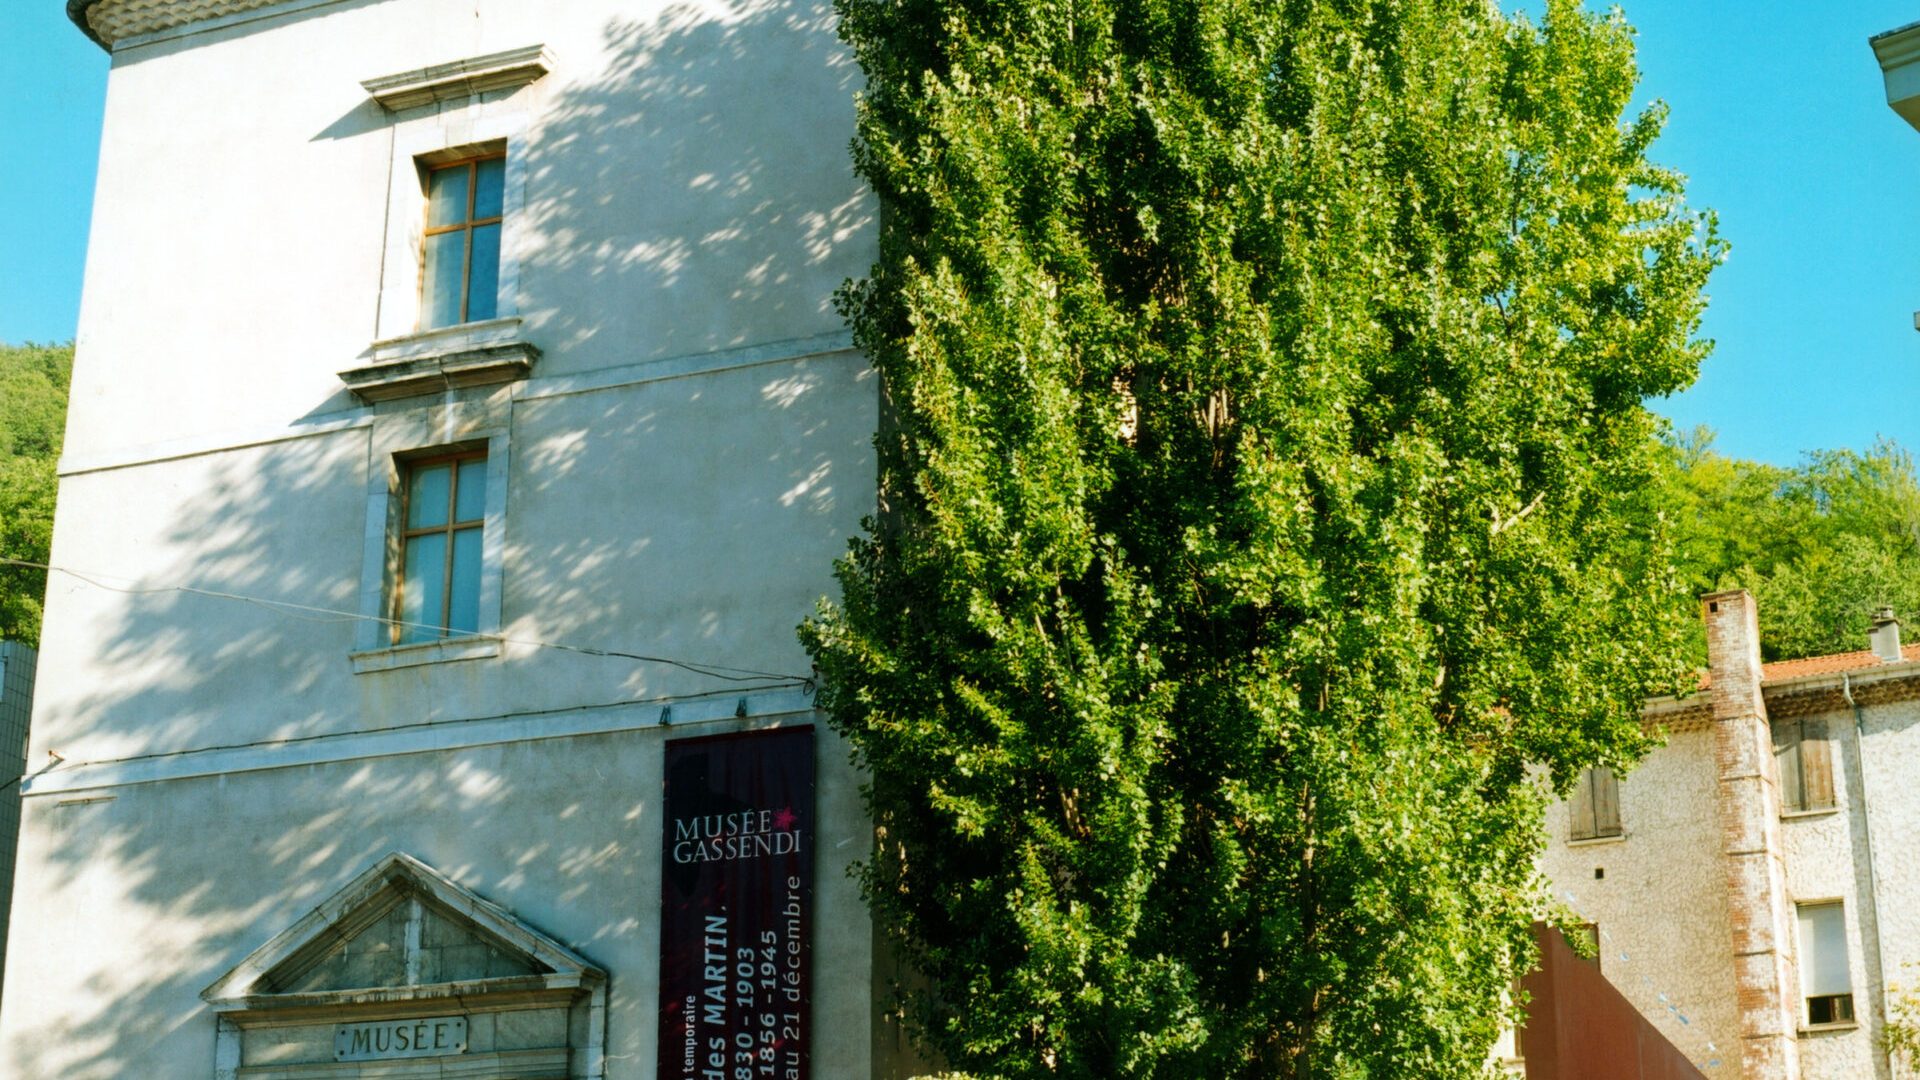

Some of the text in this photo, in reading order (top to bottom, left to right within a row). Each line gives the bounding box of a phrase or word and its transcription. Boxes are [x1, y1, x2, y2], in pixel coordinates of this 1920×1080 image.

[673, 830, 801, 864] GASSENDI
[674, 809, 772, 841] MUSÉE
[736, 947, 755, 1008] 1903
[782, 876, 801, 1080] au 21 décembre
[350, 1020, 449, 1055] MUSÉE
[682, 995, 697, 1073] temporaire
[702, 1037, 726, 1080] des
[759, 1013, 776, 1076] 1856
